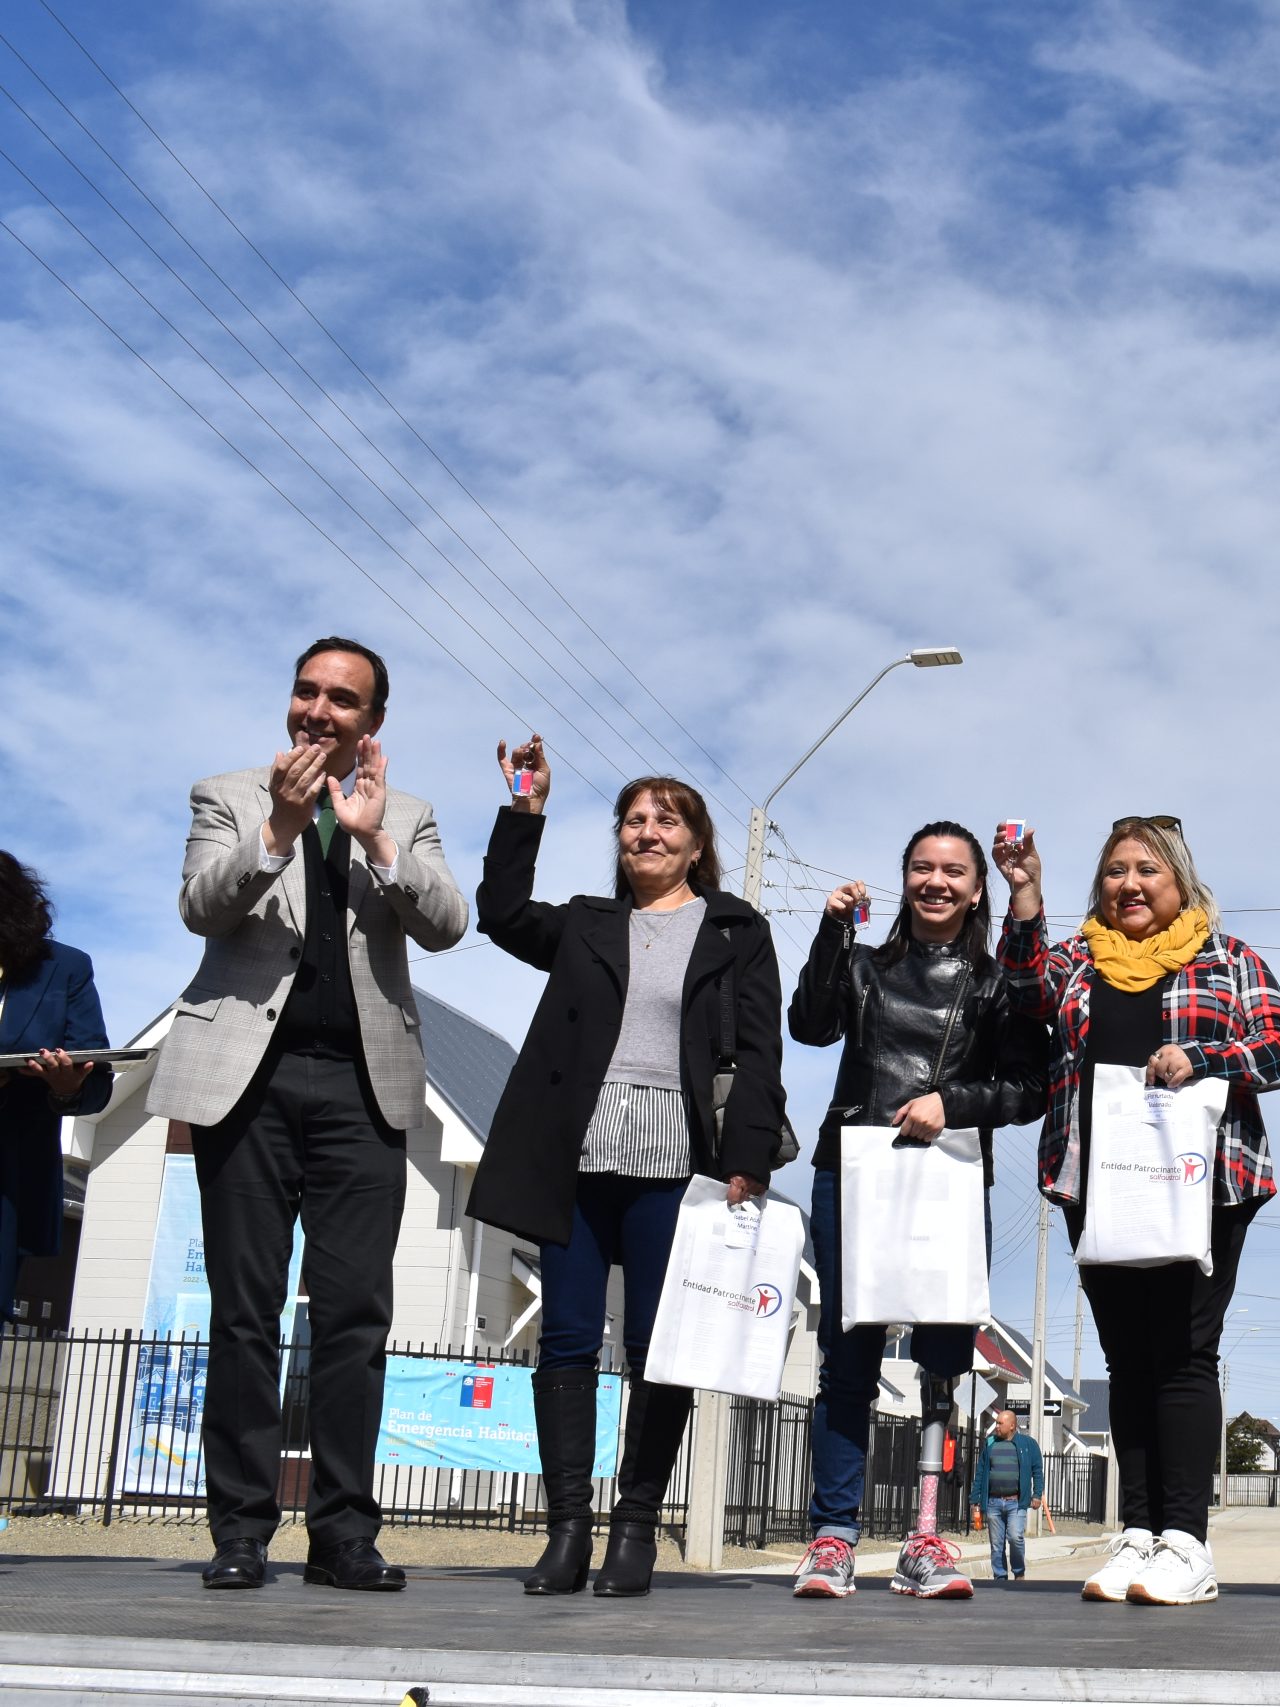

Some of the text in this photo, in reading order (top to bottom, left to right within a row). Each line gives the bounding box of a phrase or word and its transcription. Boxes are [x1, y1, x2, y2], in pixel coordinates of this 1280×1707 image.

[1100, 1161, 1181, 1174] Entidad Patrocinante
[188, 1238, 204, 1248] Pla
[682, 1278, 712, 1294] Entidad
[388, 1407, 433, 1422] Plan de
[387, 1418, 538, 1442] Emergencia Habitaci
